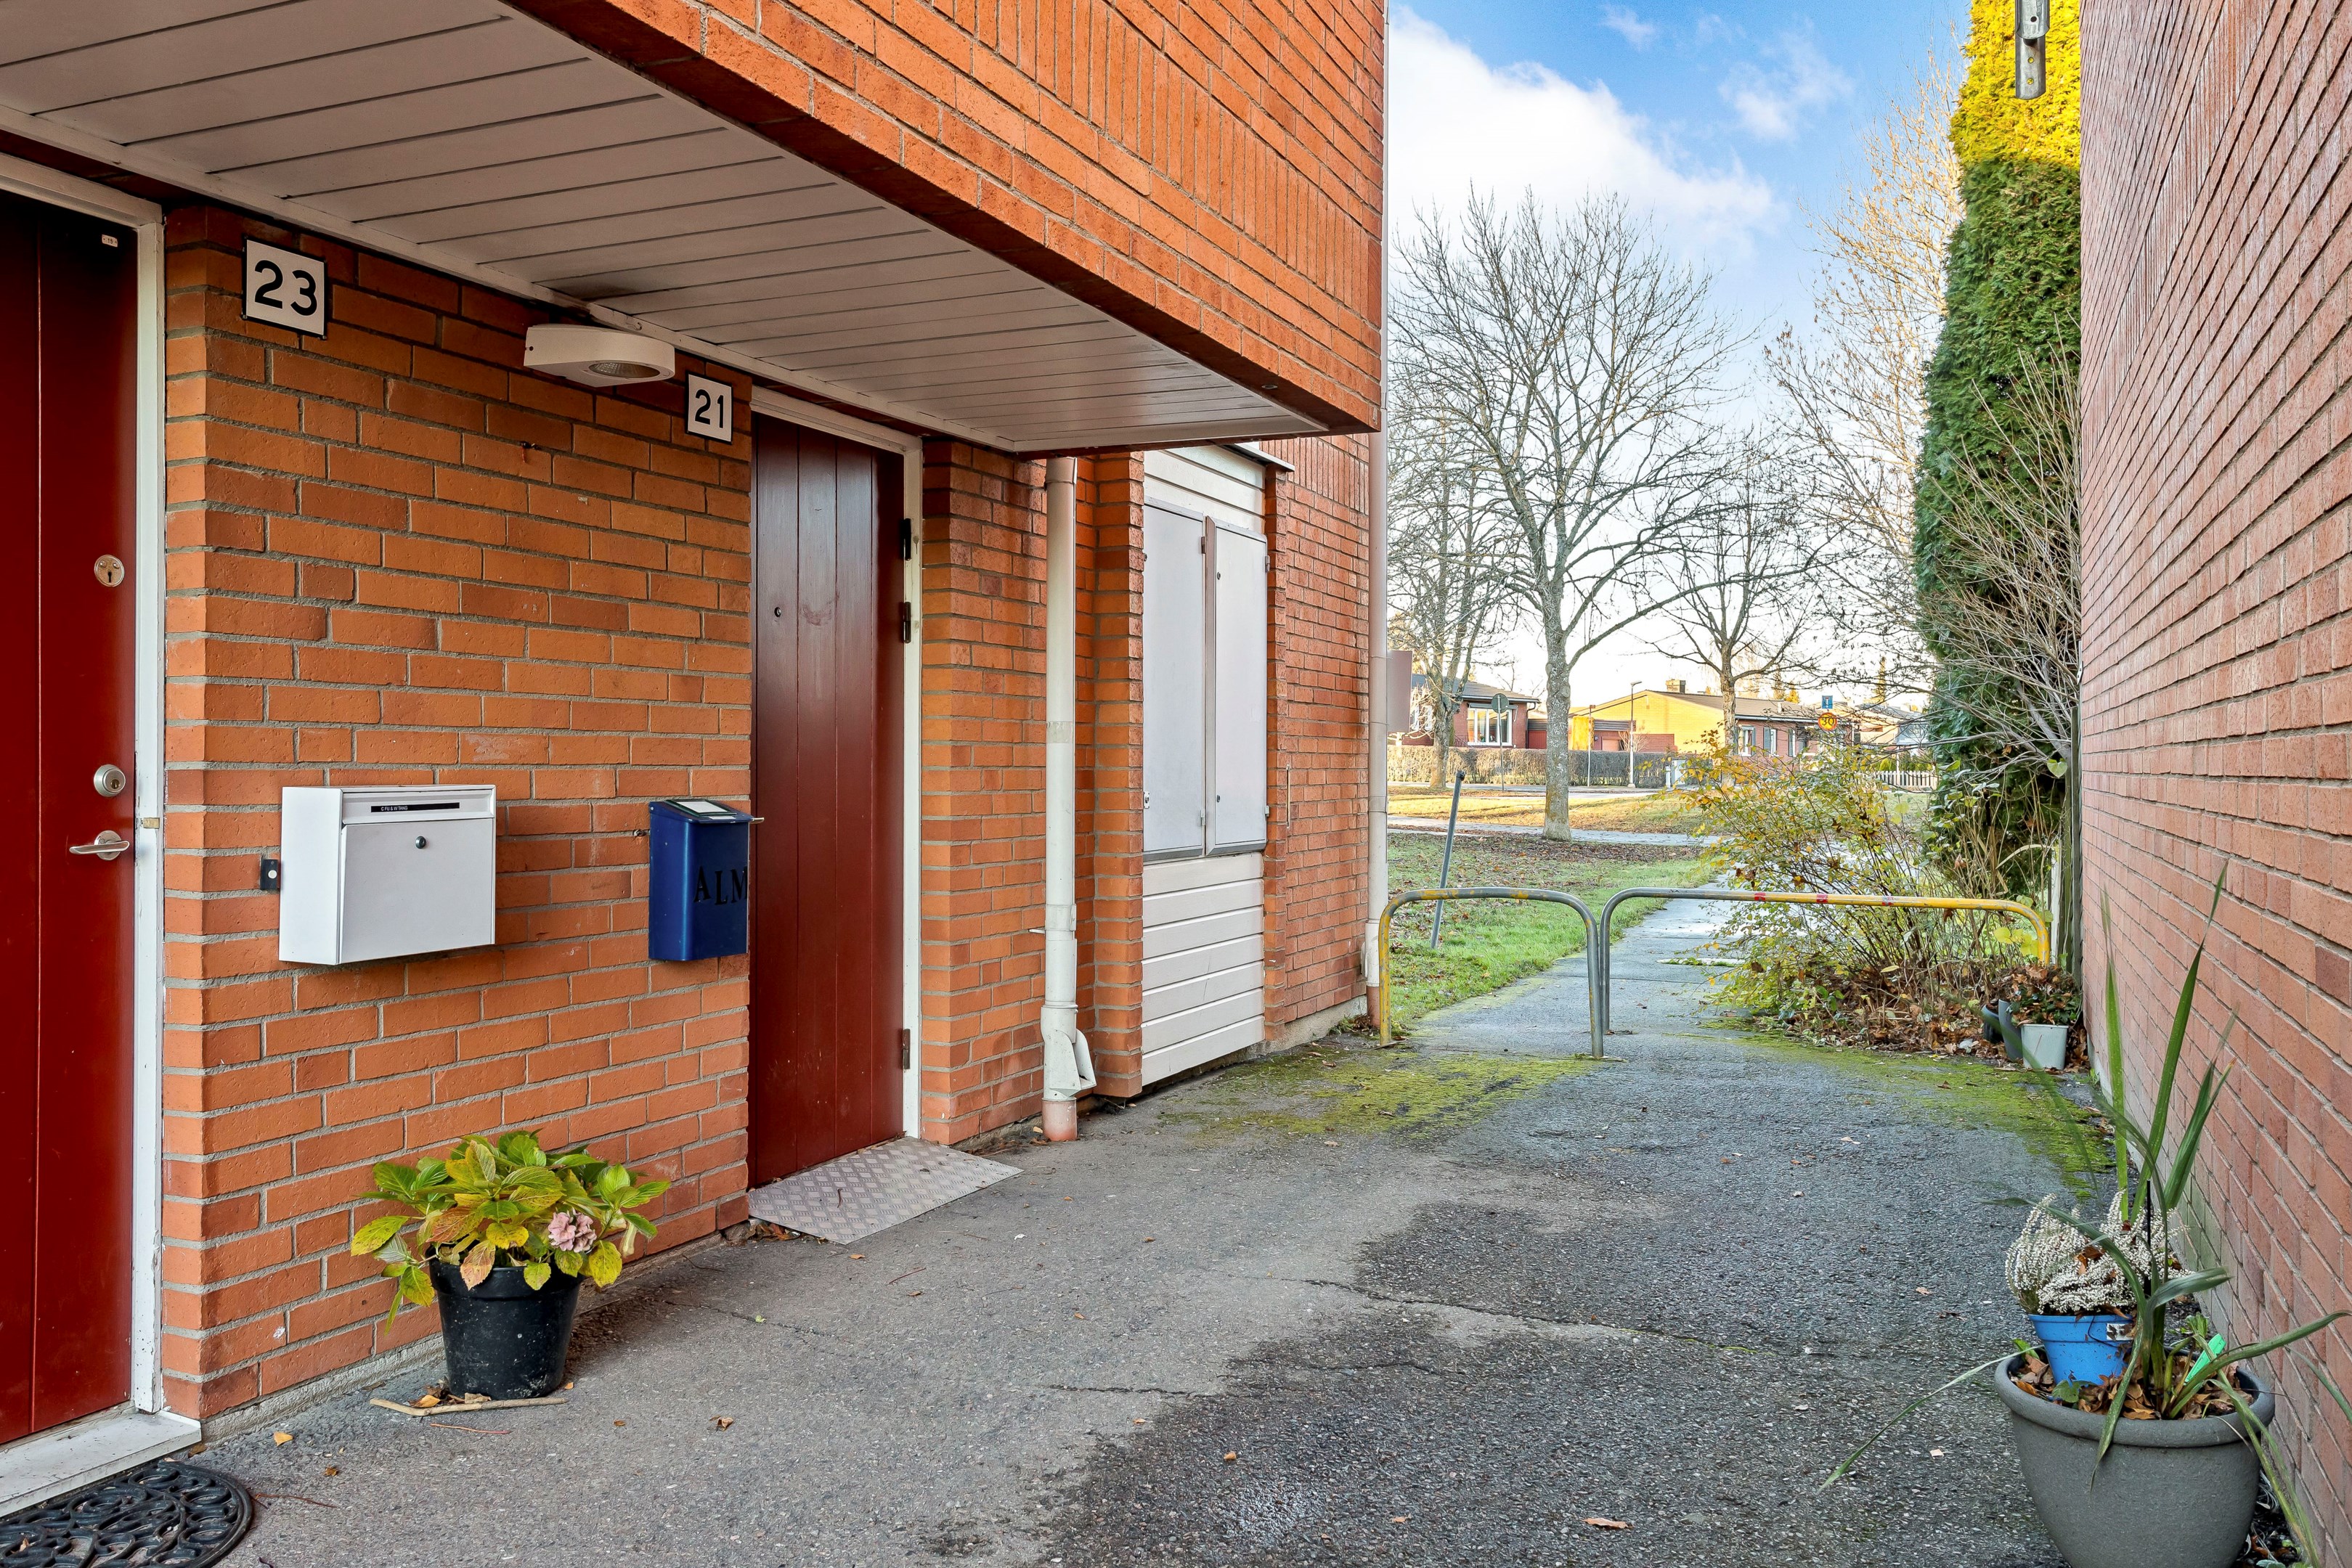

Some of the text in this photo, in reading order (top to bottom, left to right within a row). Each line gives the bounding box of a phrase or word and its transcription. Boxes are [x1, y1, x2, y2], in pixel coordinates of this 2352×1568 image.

[254, 260, 317, 316] 23
[694, 389, 724, 428] 21
[1821, 716, 1834, 726] 30
[693, 866, 748, 906] ALM
